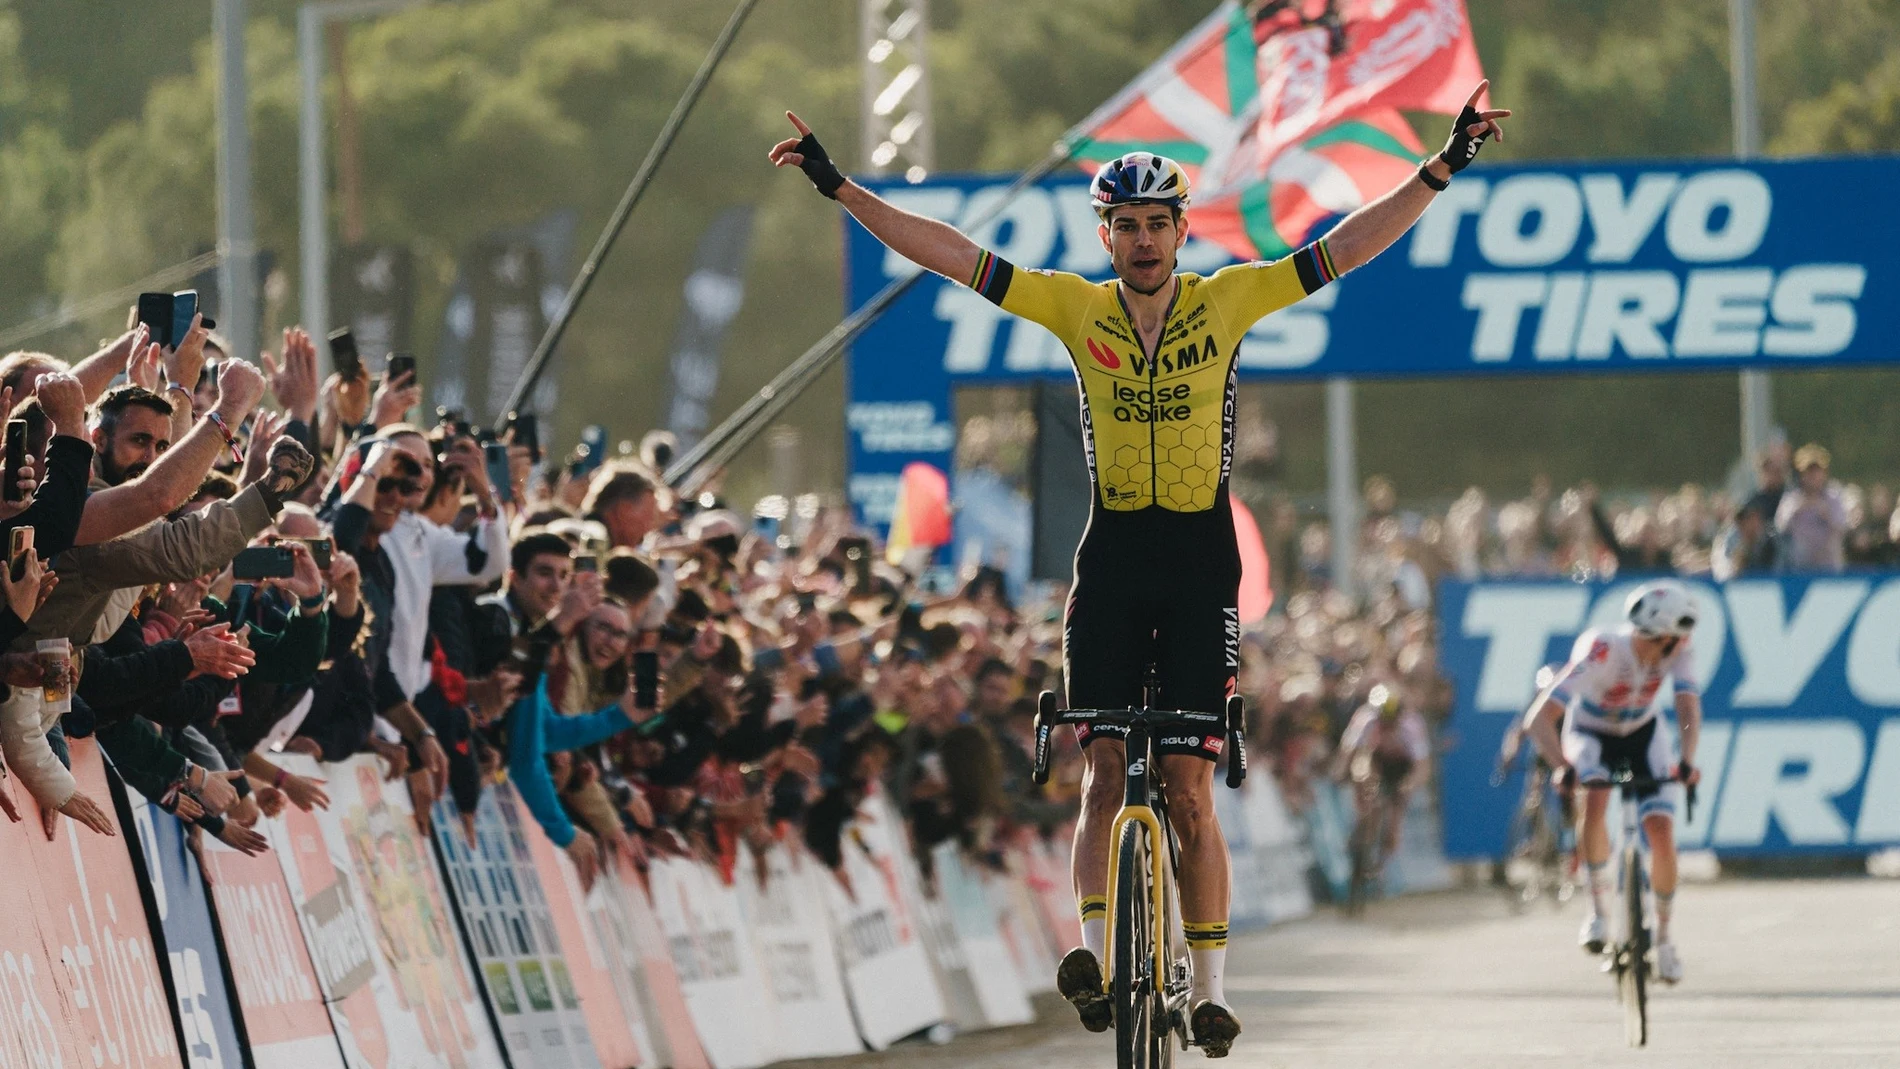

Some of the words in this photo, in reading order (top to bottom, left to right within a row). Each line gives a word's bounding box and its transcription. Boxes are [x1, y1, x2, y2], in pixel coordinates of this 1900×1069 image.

[1408, 169, 1773, 268] TOYO
[1461, 262, 1868, 363] TIRES
[1129, 334, 1218, 377] VISMA
[1113, 380, 1191, 405] lease
[1220, 355, 1240, 484] BETCITY.NL
[1160, 736, 1188, 746] AGU
